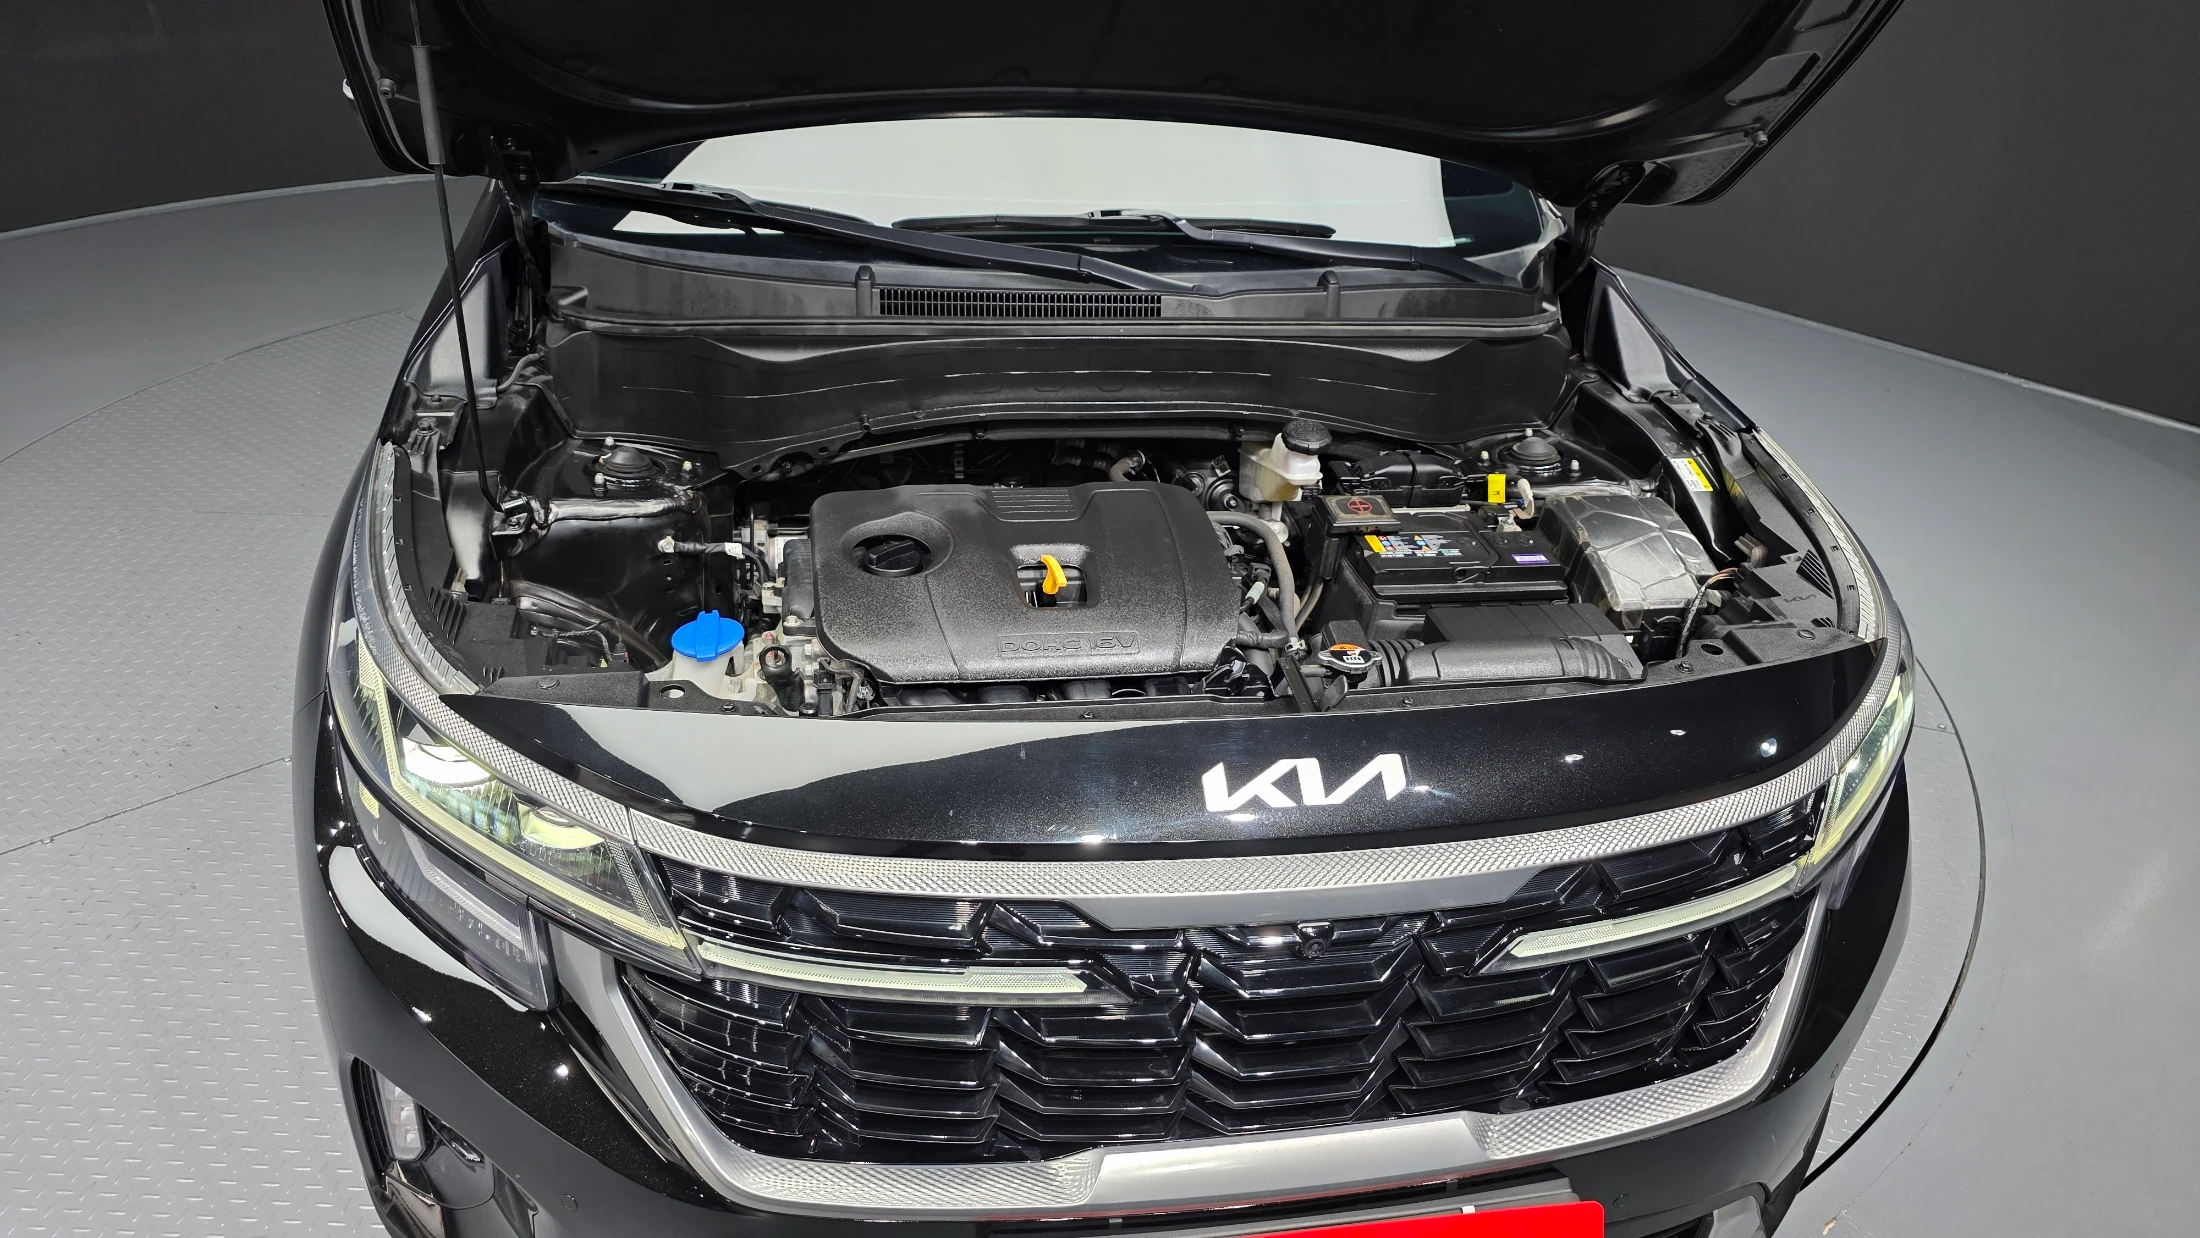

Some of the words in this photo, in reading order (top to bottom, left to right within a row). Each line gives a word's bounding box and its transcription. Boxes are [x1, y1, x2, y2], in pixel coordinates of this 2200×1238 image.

[1000, 638, 1082, 652] DOHC
[1088, 635, 1136, 650] 16V
[1202, 753, 1406, 812] KIA
